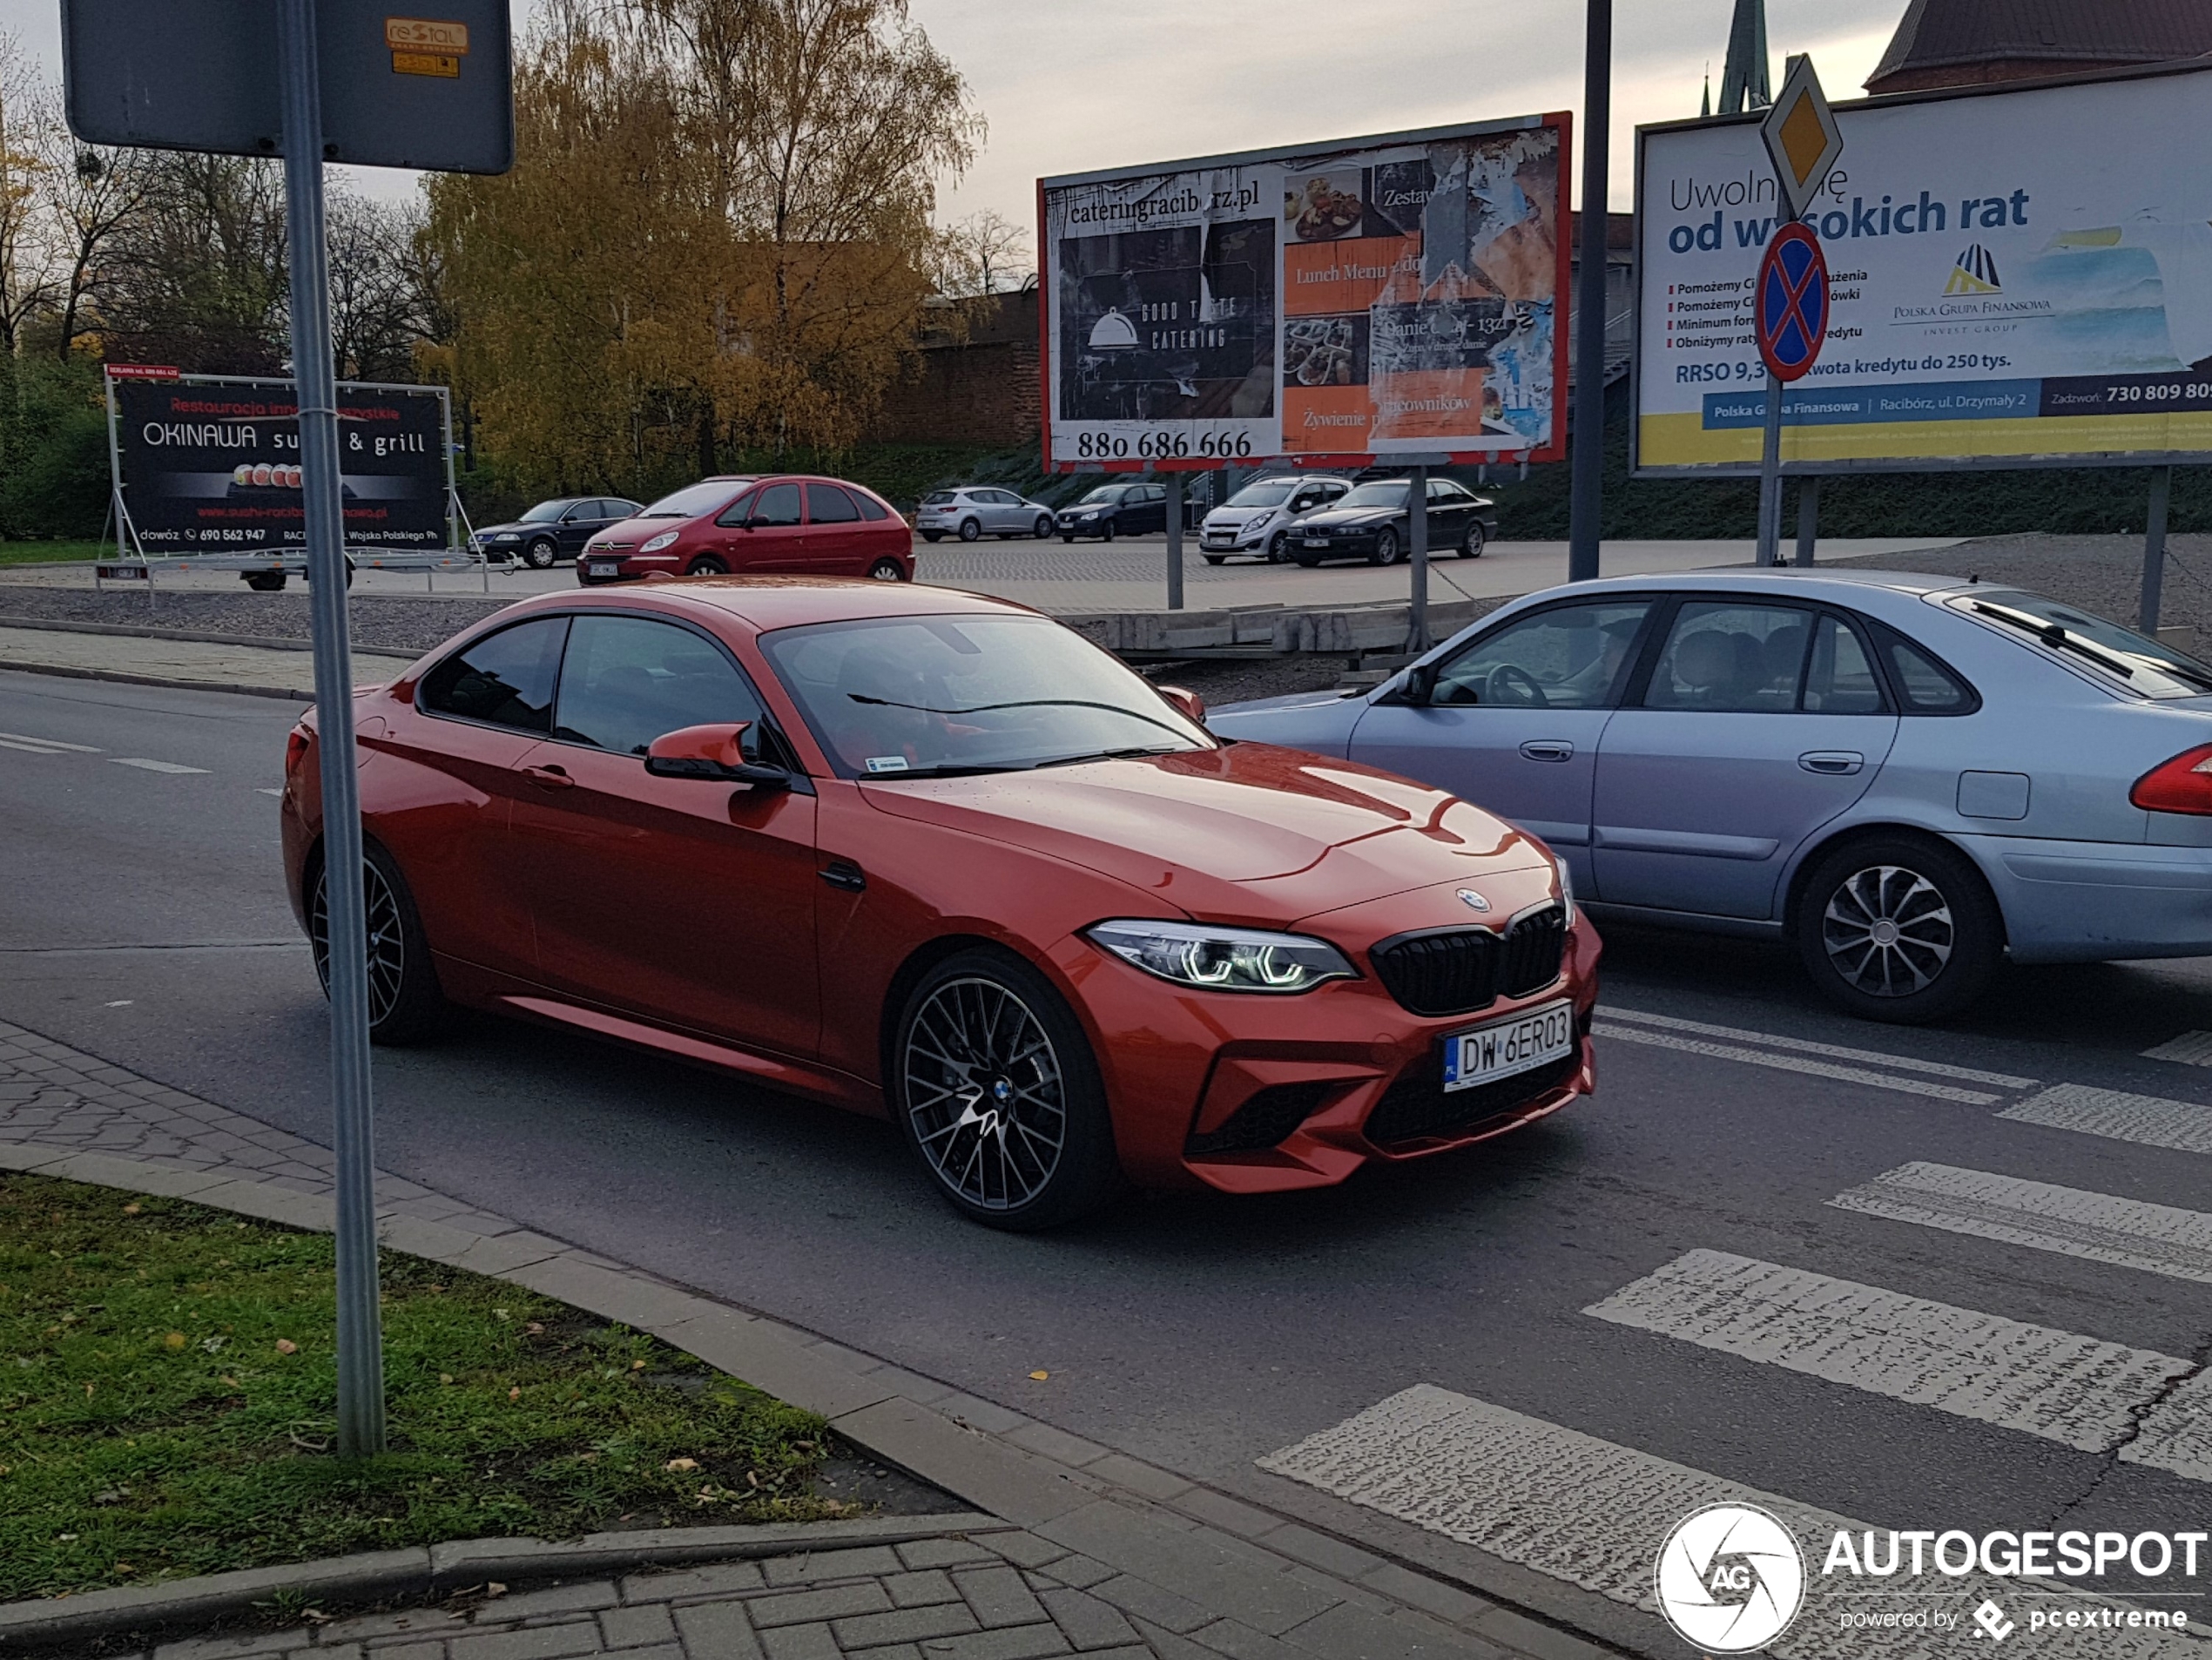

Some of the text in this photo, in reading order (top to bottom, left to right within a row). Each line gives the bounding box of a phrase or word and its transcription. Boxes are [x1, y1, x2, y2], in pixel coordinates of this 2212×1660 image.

[1671, 170, 1775, 211] Uwoln
[1071, 180, 1259, 224] cateringracibrz.pl
[1669, 211, 1723, 253] od
[1960, 188, 2030, 229] rat
[1297, 263, 1339, 284] Lunch
[1343, 262, 1386, 280] Menu
[1677, 280, 1741, 294] Pomożemy
[1743, 278, 1755, 289] Ci
[1142, 297, 1236, 322] GOOD TSTE
[1677, 299, 1740, 312] Pomożemy
[1743, 296, 1754, 307] Ci
[1676, 318, 1731, 330] Minimum
[1924, 324, 2018, 335] INVEST GROUP
[1152, 328, 1224, 349] CATERING
[1676, 335, 1734, 348] Obniżymy
[1676, 361, 1730, 383] RRSO
[1855, 357, 1917, 375] kredytu
[1921, 355, 1943, 369] do
[1947, 354, 1978, 368] 250
[1982, 354, 2012, 370] tys.
[2051, 382, 2212, 404] Zadzwoń: 730 809 80
[171, 397, 266, 416] Restauracja
[1714, 405, 1752, 418] Polska
[1794, 402, 1859, 414] Finansowa
[1879, 397, 1935, 411] Racibórz,
[1939, 395, 1952, 408] ul.
[1956, 394, 2015, 410] Drzymały
[2018, 394, 2027, 406] 2
[1303, 408, 1366, 430] Żywienie
[143, 422, 257, 448] OKINAWA
[349, 432, 363, 450] &
[374, 434, 425, 456] grill
[1078, 431, 1251, 457] 880 686 666
[139, 528, 179, 541] dowóz
[199, 530, 220, 541] 690
[222, 530, 243, 541] 562
[245, 529, 266, 541] 947
[349, 530, 381, 542] Wojska
[382, 530, 424, 542] Polskiego
[1464, 1011, 1567, 1075] DW 6ER03
[1446, 1065, 1456, 1075] PL
